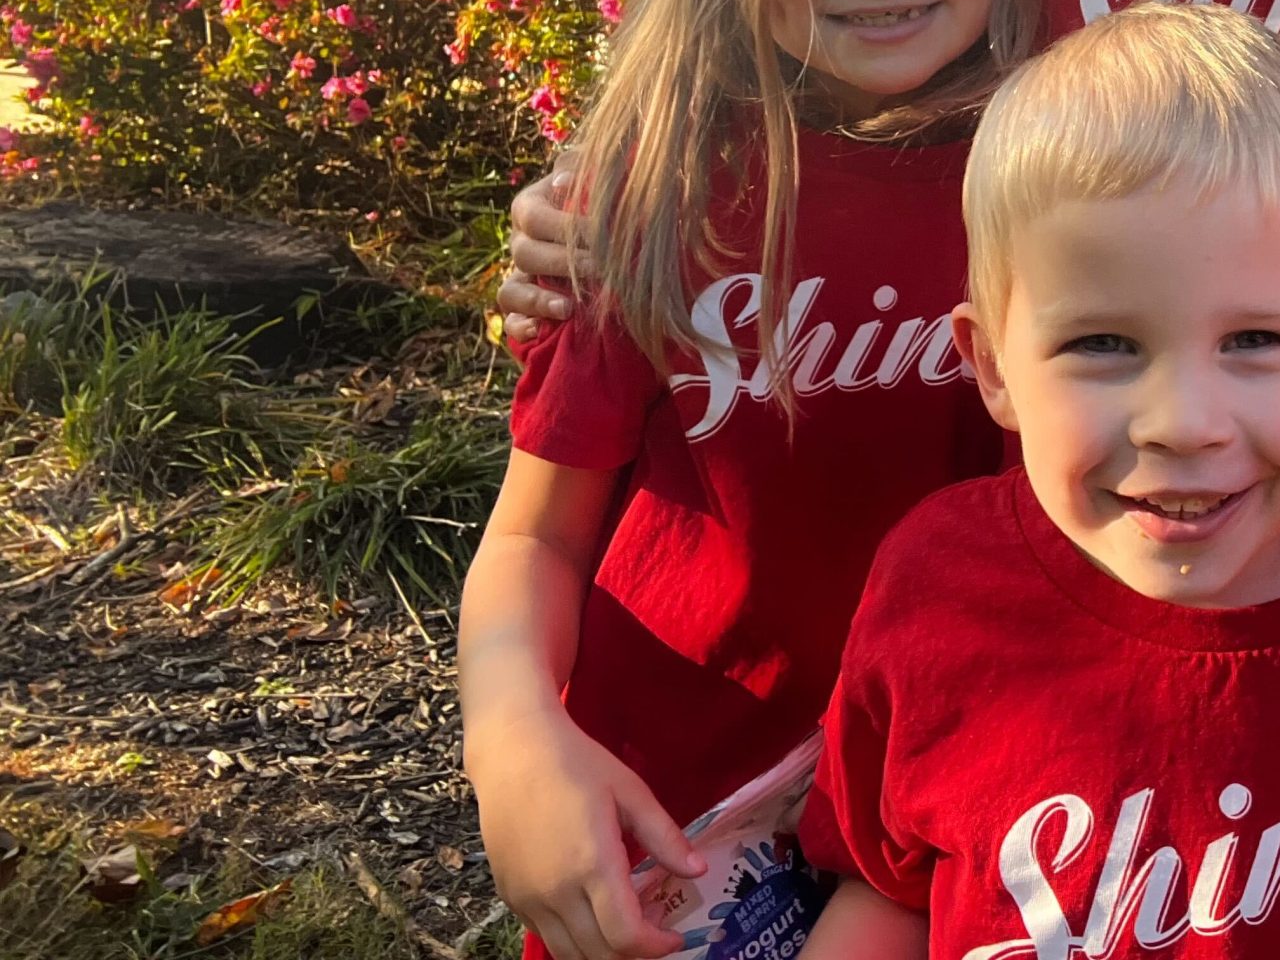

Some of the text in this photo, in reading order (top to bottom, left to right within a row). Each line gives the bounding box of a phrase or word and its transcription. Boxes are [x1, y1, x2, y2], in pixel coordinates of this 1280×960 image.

[670, 272, 979, 444] Shin
[761, 863, 784, 879] STAGE
[734, 884, 773, 923] MIXED
[740, 896, 777, 934] BERRY
